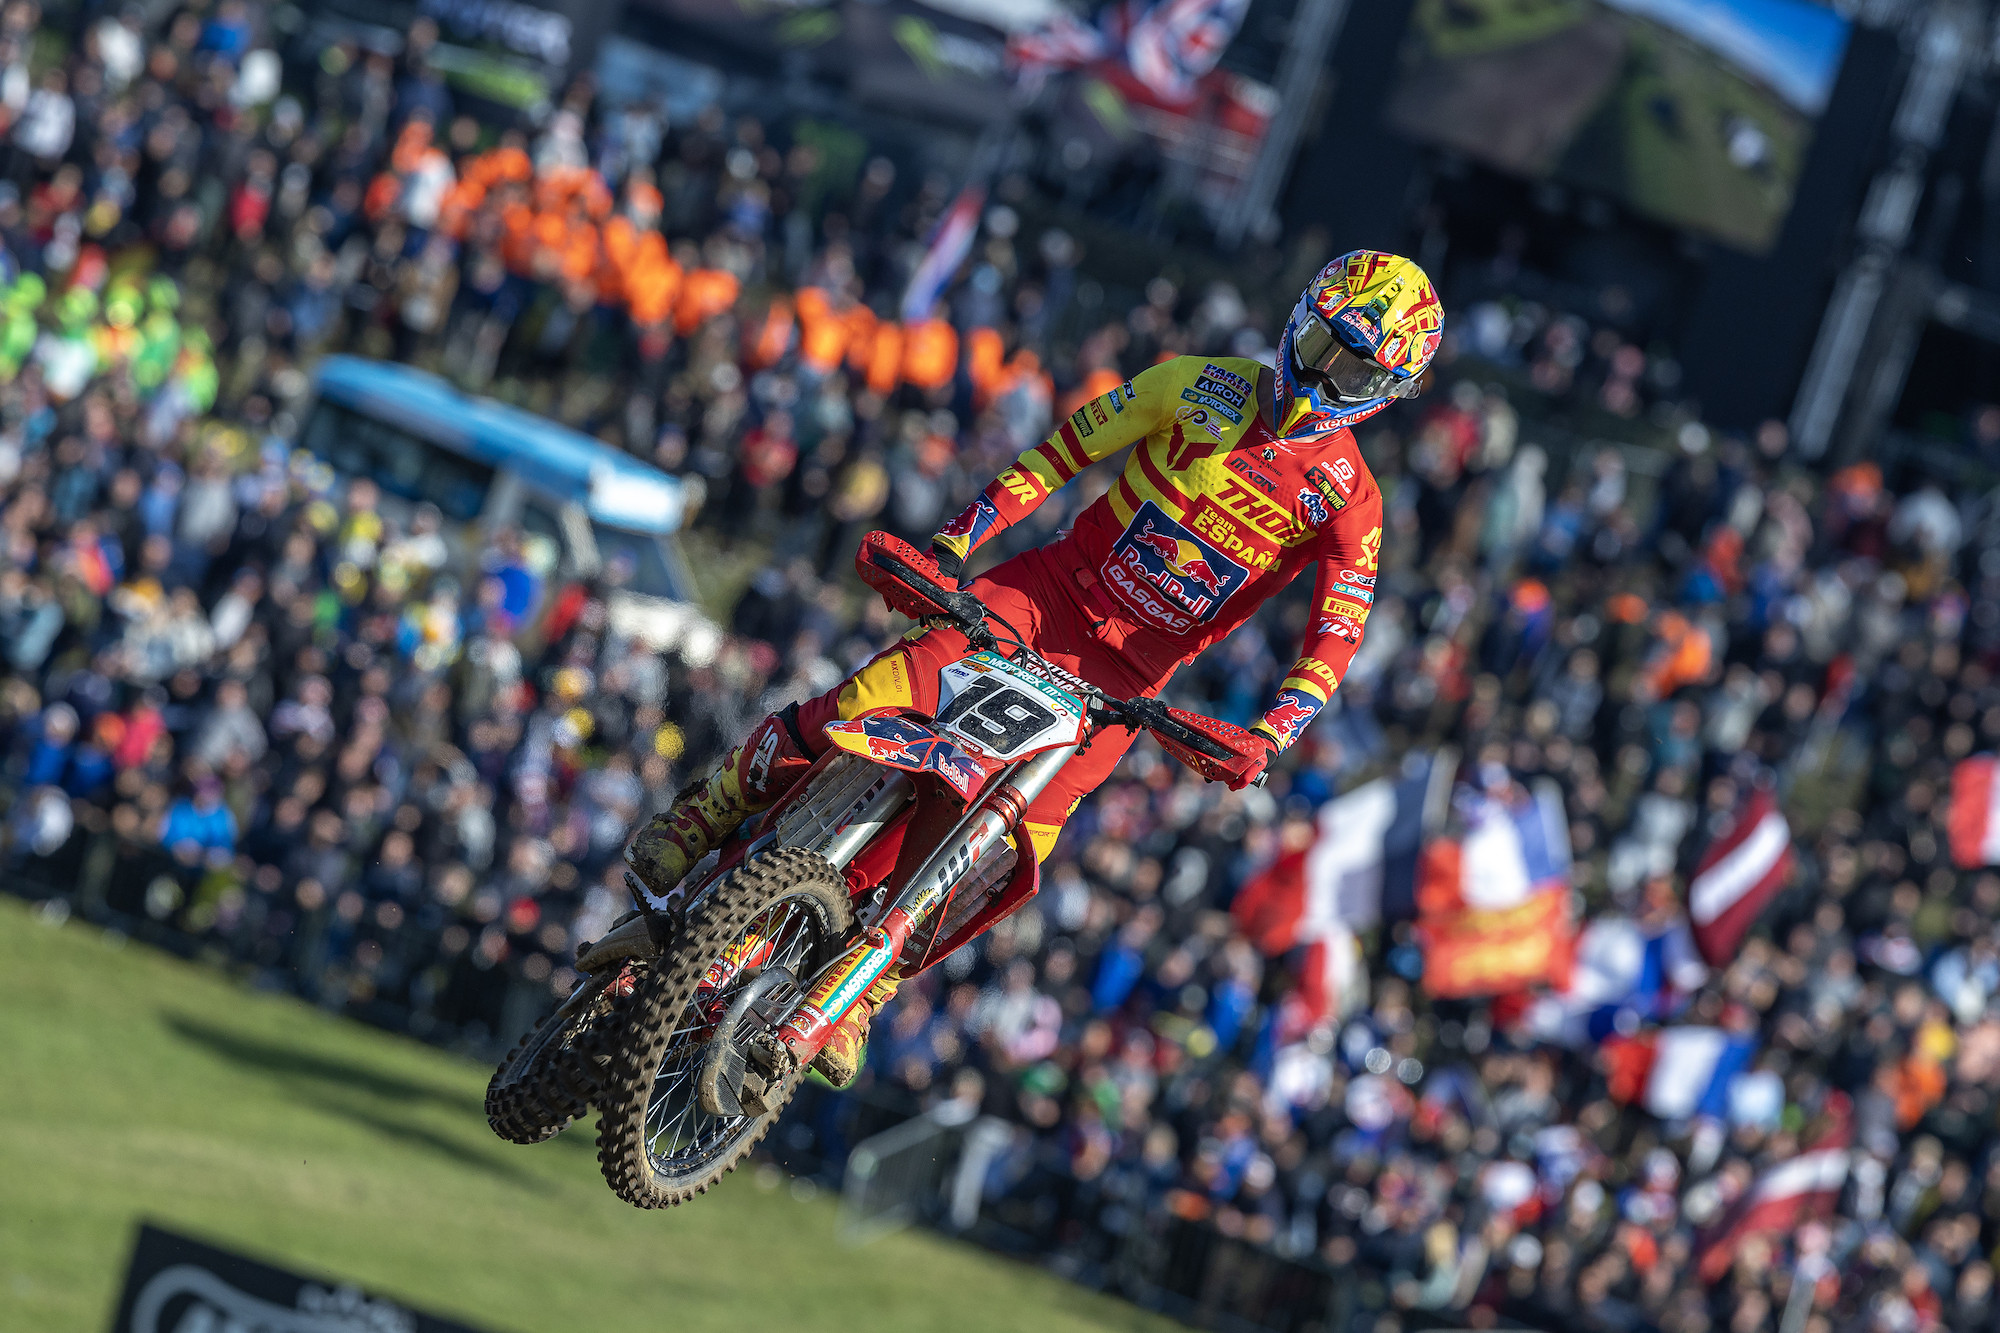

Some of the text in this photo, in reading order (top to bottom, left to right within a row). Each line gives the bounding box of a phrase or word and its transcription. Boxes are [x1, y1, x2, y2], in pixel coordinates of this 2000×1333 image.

[1199, 380, 1243, 406] AIROH
[1204, 363, 1253, 394] PARTS
[1198, 396, 1239, 421] MOTOREX
[997, 466, 1039, 506] OR
[1321, 461, 1351, 494] GASGAS
[1203, 504, 1237, 533] Team
[1192, 512, 1282, 572] ESPAÑA
[1108, 564, 1191, 628] GASGAS
[1347, 587, 1370, 603] MOTO
[988, 658, 1043, 687] MOTOREX
[1012, 657, 1079, 697] RENTHA
[938, 674, 1060, 760] 19
[951, 732, 980, 752] ASGAS
[840, 946, 892, 1003] MOTOREX
